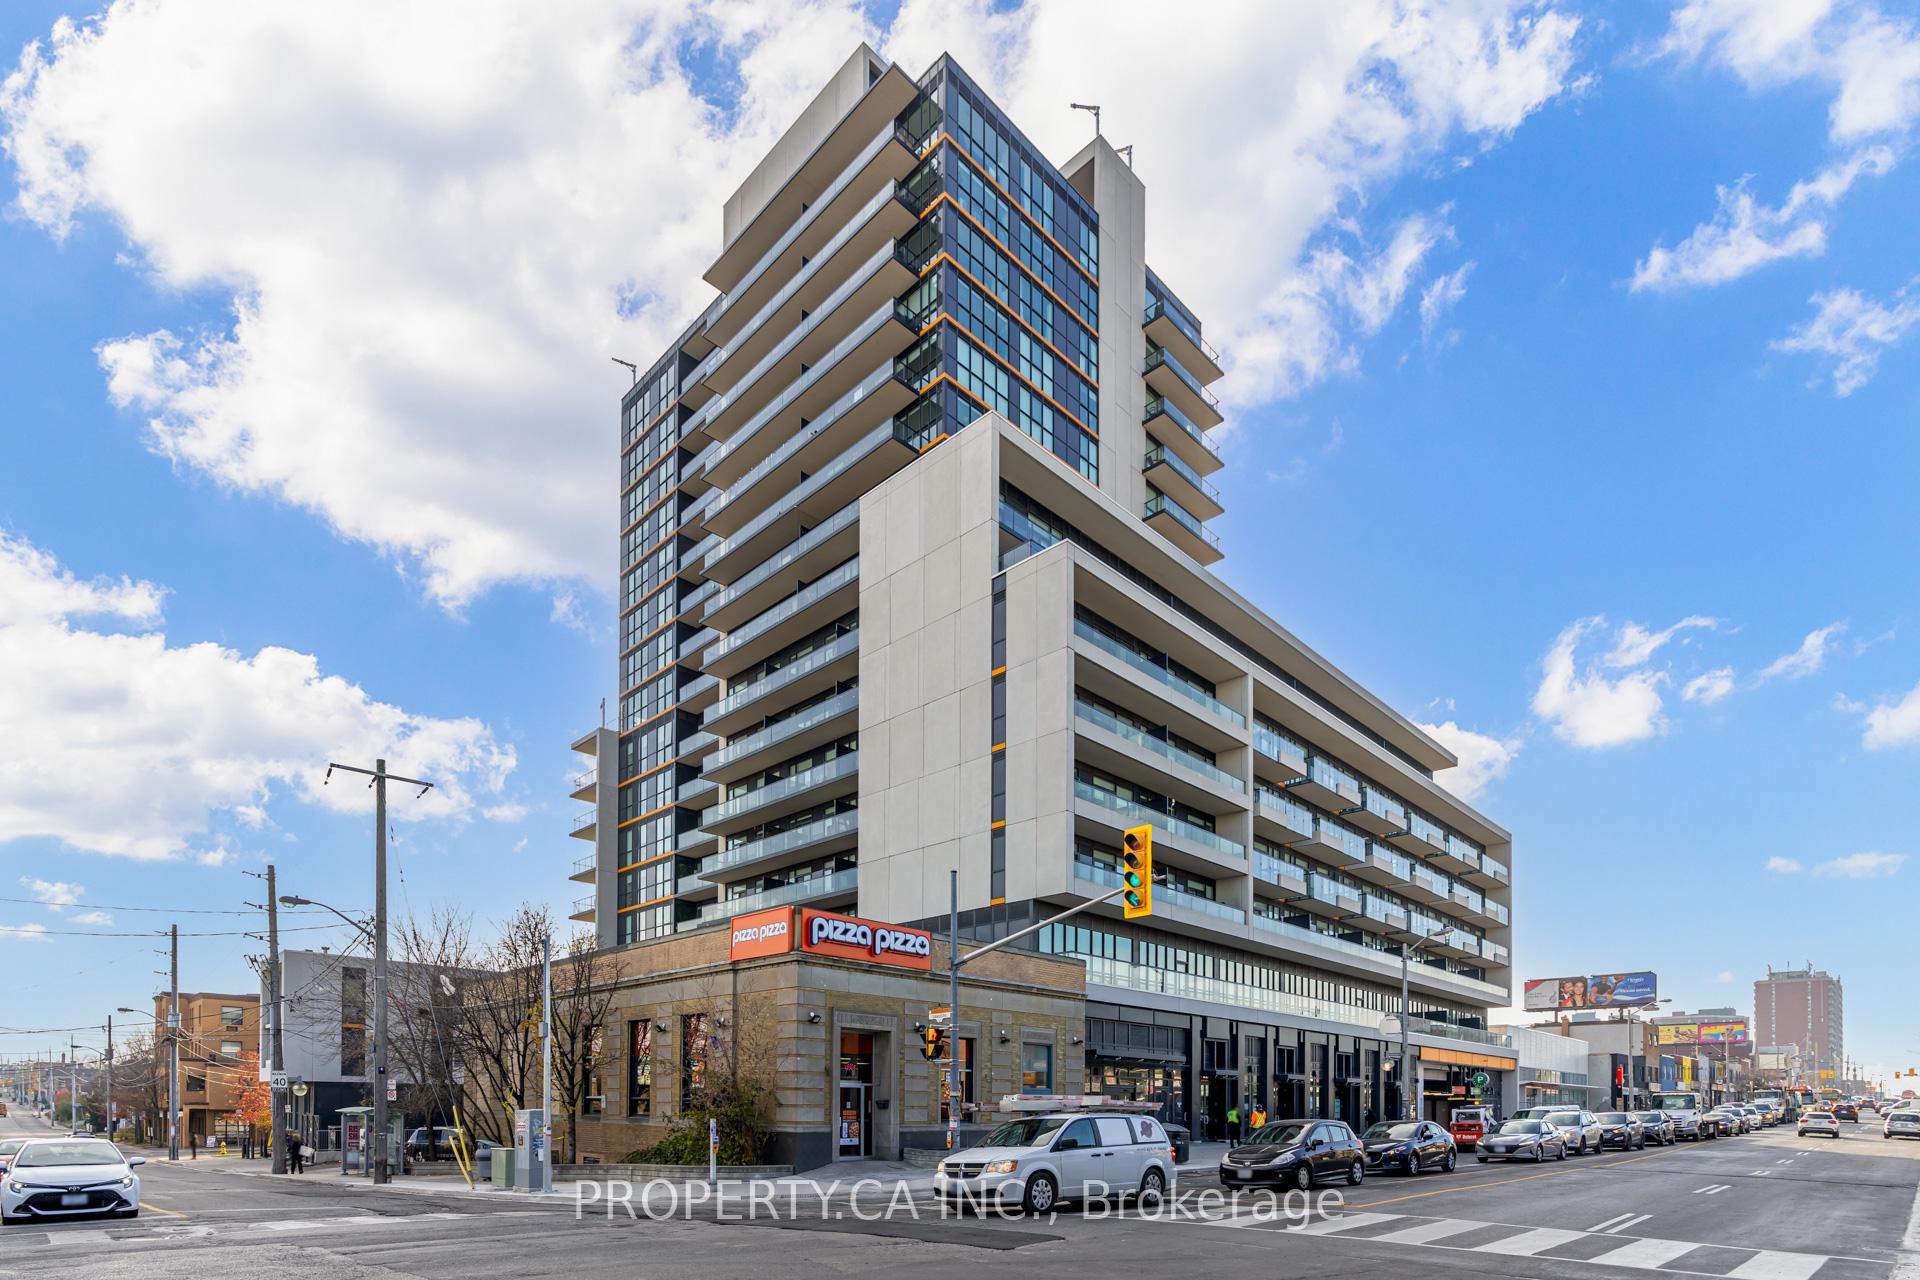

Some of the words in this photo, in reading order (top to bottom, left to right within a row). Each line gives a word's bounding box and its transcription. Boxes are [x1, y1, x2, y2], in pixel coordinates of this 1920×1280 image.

[732, 927, 758, 947] pizza
[759, 921, 787, 942] pizza
[811, 916, 873, 945] pizza
[874, 928, 930, 956] pizza
[272, 1077, 286, 1087] 40
